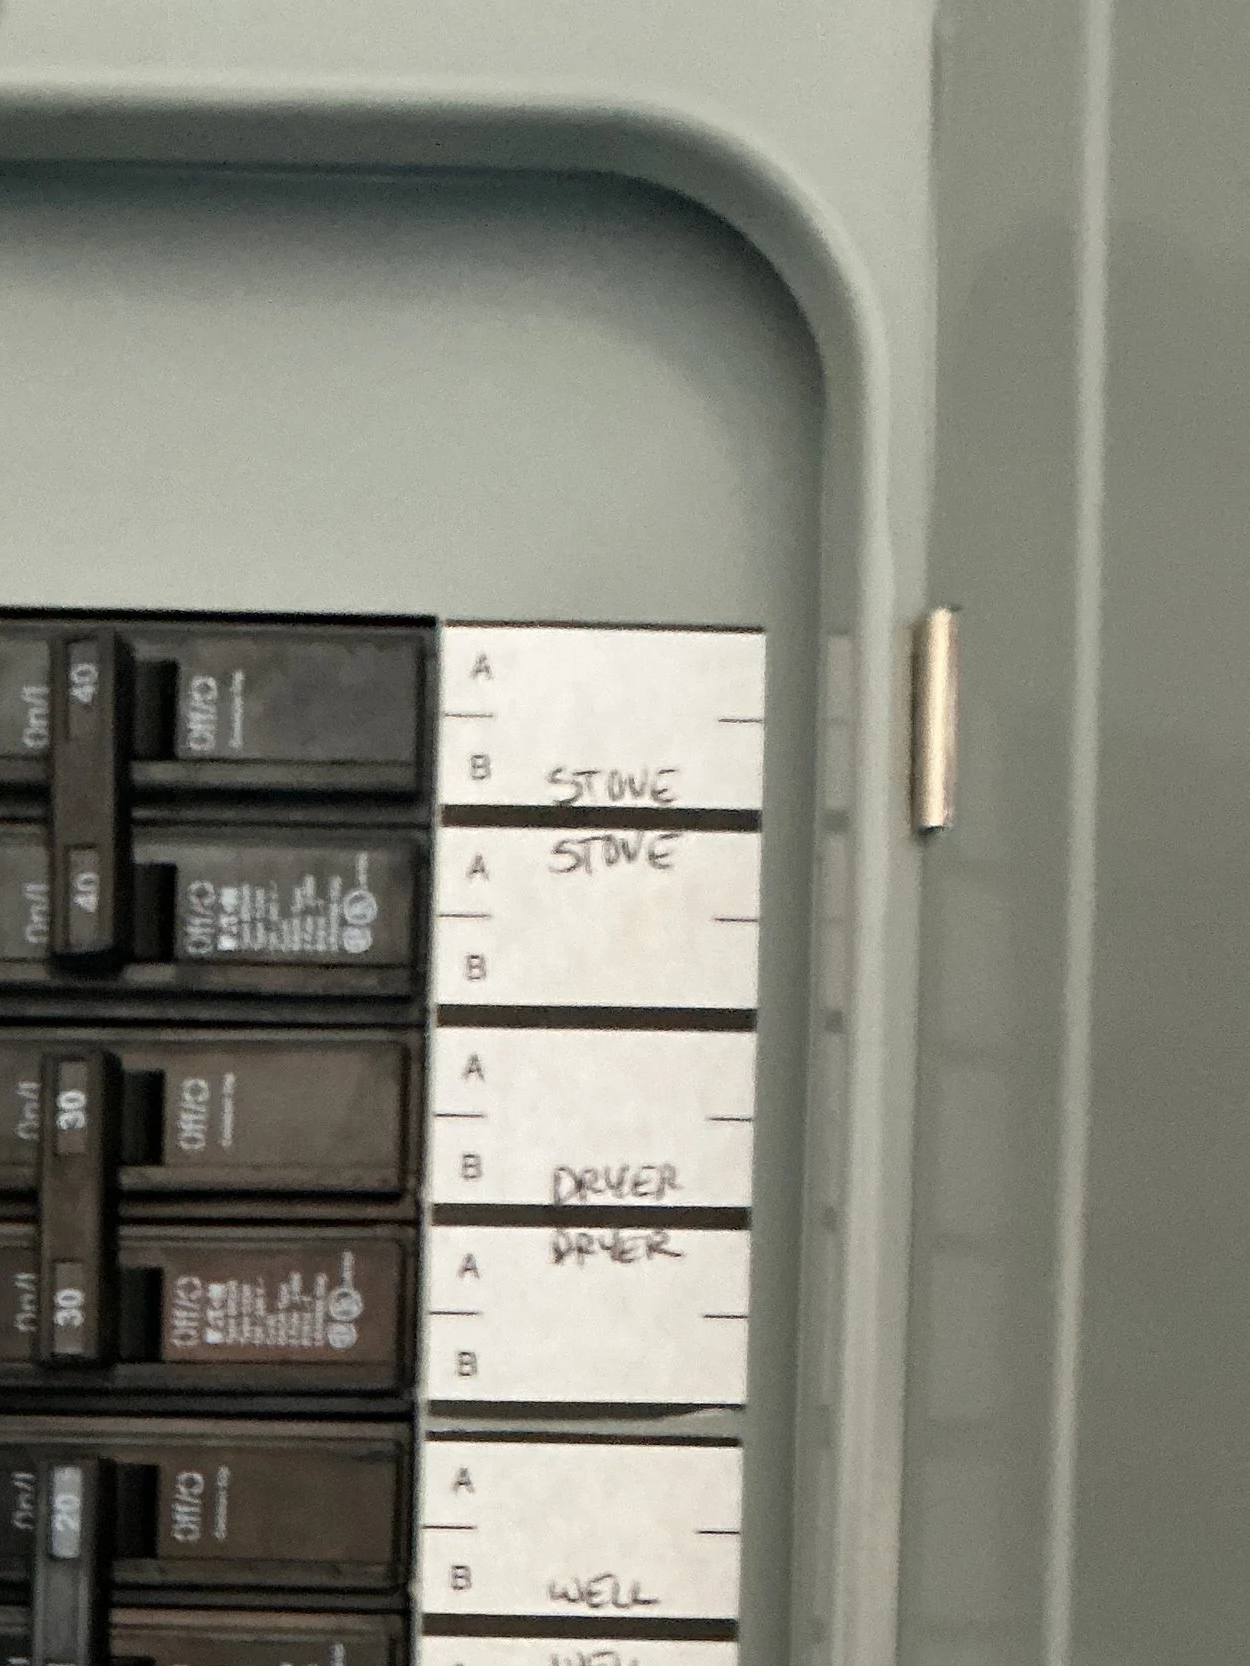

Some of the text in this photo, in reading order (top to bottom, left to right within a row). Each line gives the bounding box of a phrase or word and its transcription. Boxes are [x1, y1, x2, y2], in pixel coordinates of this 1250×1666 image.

[547, 765, 679, 807] STOVE
[466, 854, 489, 880] A
[548, 831, 684, 875] STOVE
[464, 954, 487, 982] B
[56, 1089, 88, 1130] 30
[553, 1163, 684, 1205] DRYER
[457, 1253, 480, 1279] A
[551, 1228, 682, 1268] DRYER
[54, 1288, 85, 1328] 30
[454, 1350, 478, 1377] B
[547, 1572, 661, 1609] WELL
